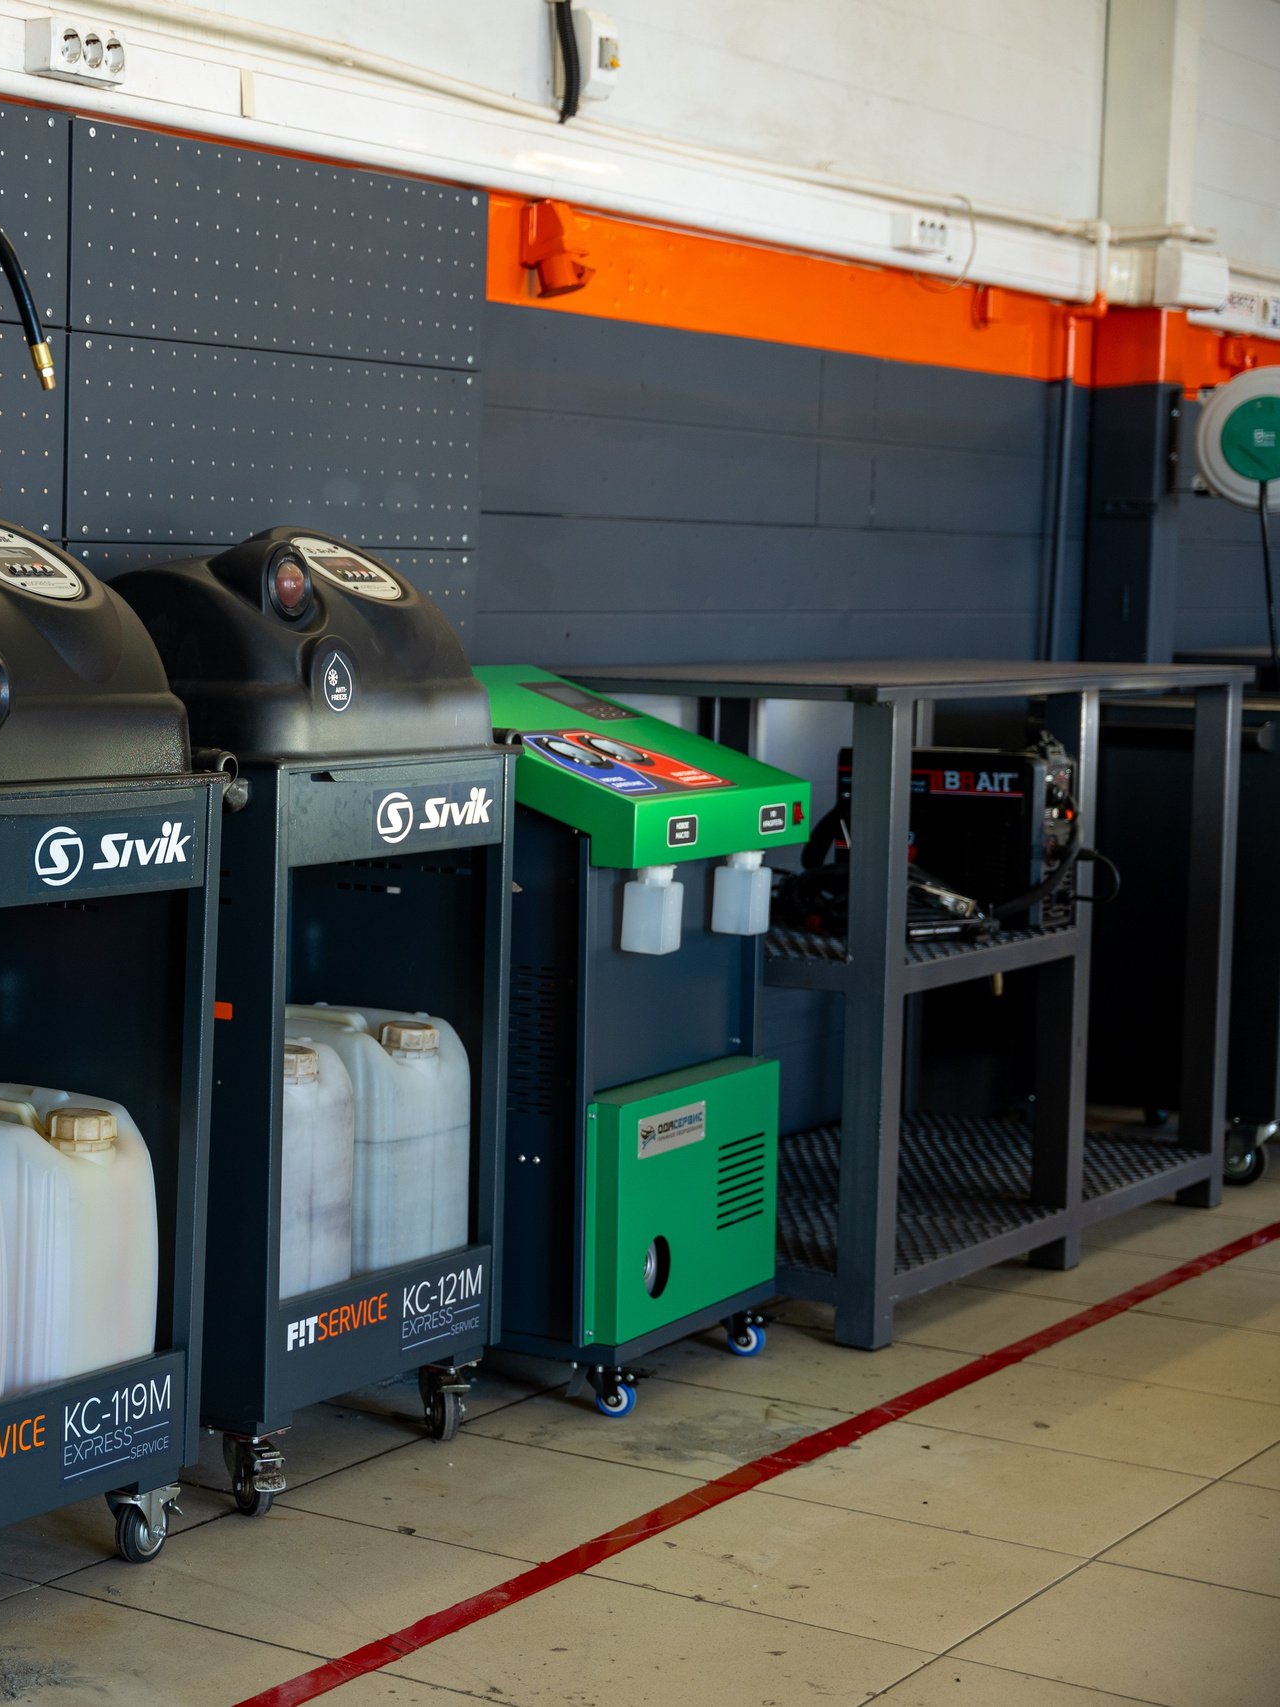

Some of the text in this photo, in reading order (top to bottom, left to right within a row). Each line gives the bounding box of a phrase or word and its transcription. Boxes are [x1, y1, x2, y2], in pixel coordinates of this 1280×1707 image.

[330, 693, 348, 701] FREEZE
[944, 770, 1013, 792] BRAIT
[402, 1264, 483, 1319] KC-121M
[402, 1306, 454, 1339] EXPRESS
[450, 1316, 480, 1336] SERVICE
[63, 1374, 171, 1442] KC-119M
[63, 1426, 134, 1467] EXPRESS
[130, 1435, 170, 1461] SERVICE
